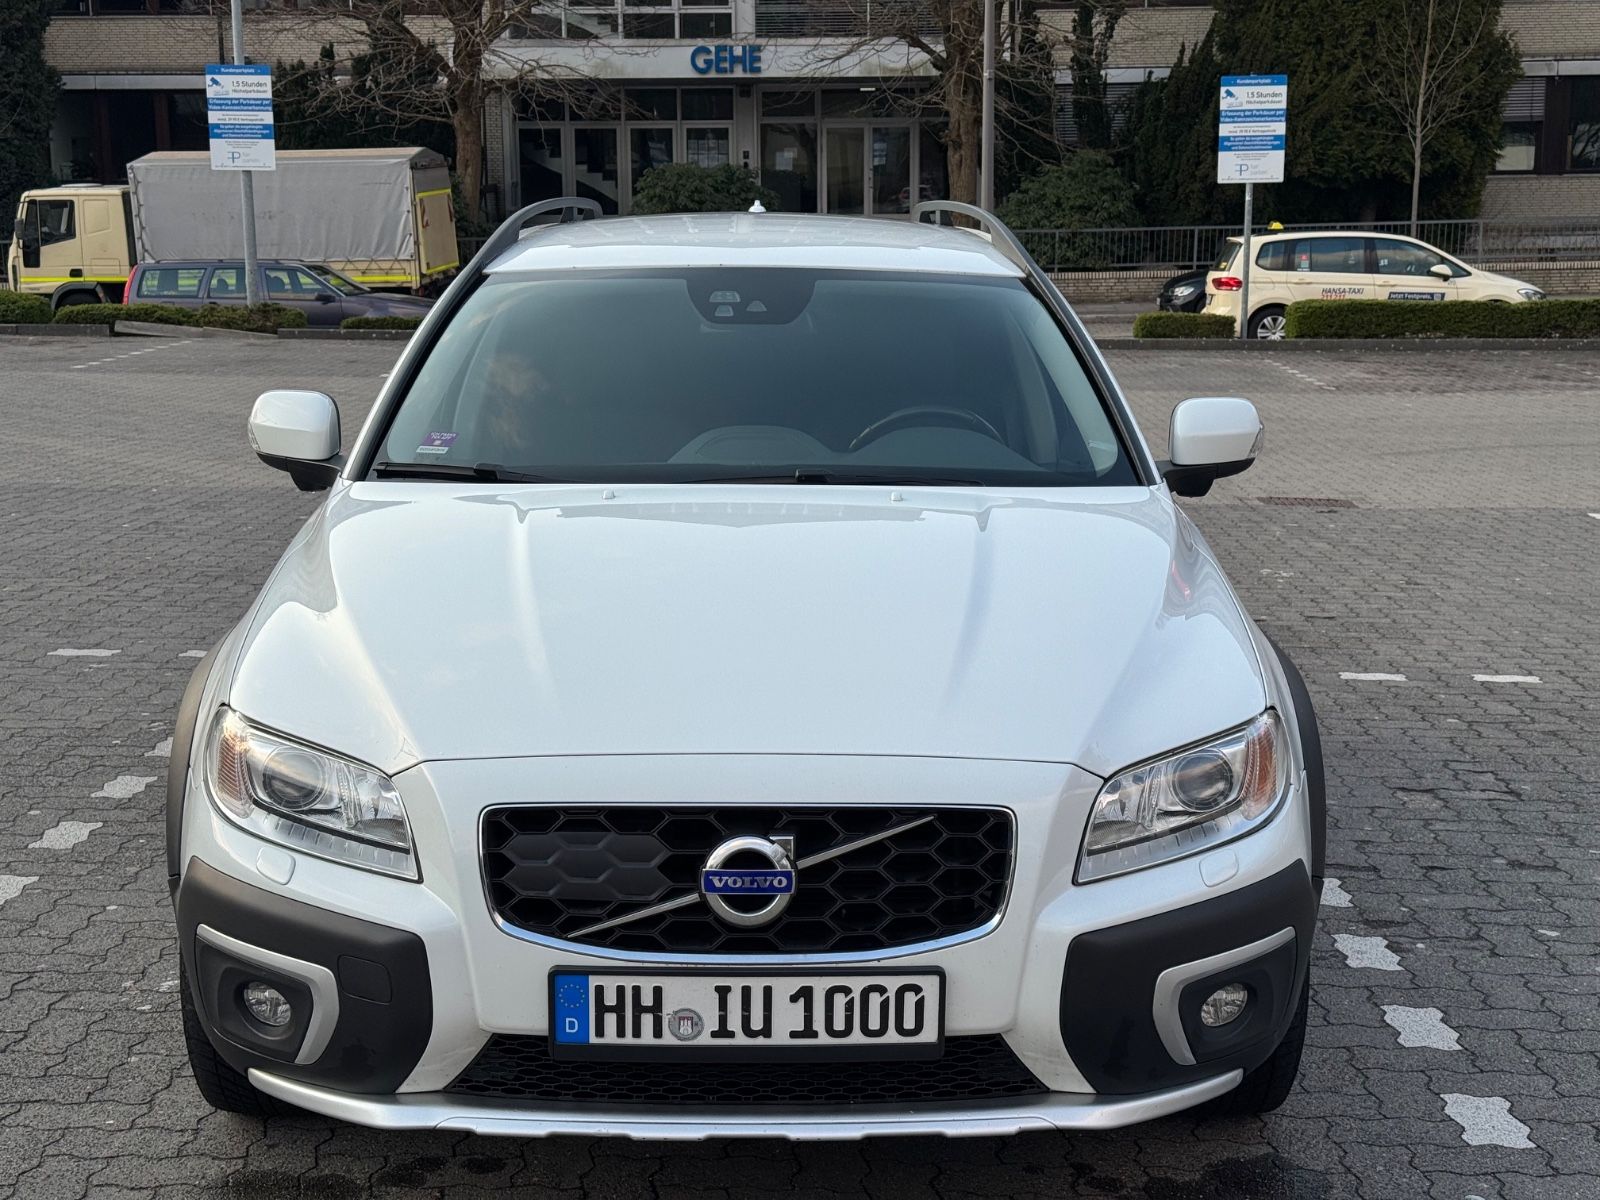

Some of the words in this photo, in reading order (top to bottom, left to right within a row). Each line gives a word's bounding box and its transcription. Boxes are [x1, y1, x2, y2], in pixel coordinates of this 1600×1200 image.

[690, 45, 762, 75] GEHE
[709, 876, 788, 888] VOLVO
[594, 984, 663, 1039] HH
[710, 984, 773, 1039] IU
[789, 983, 925, 1039] 1000
[565, 1017, 579, 1033] D
